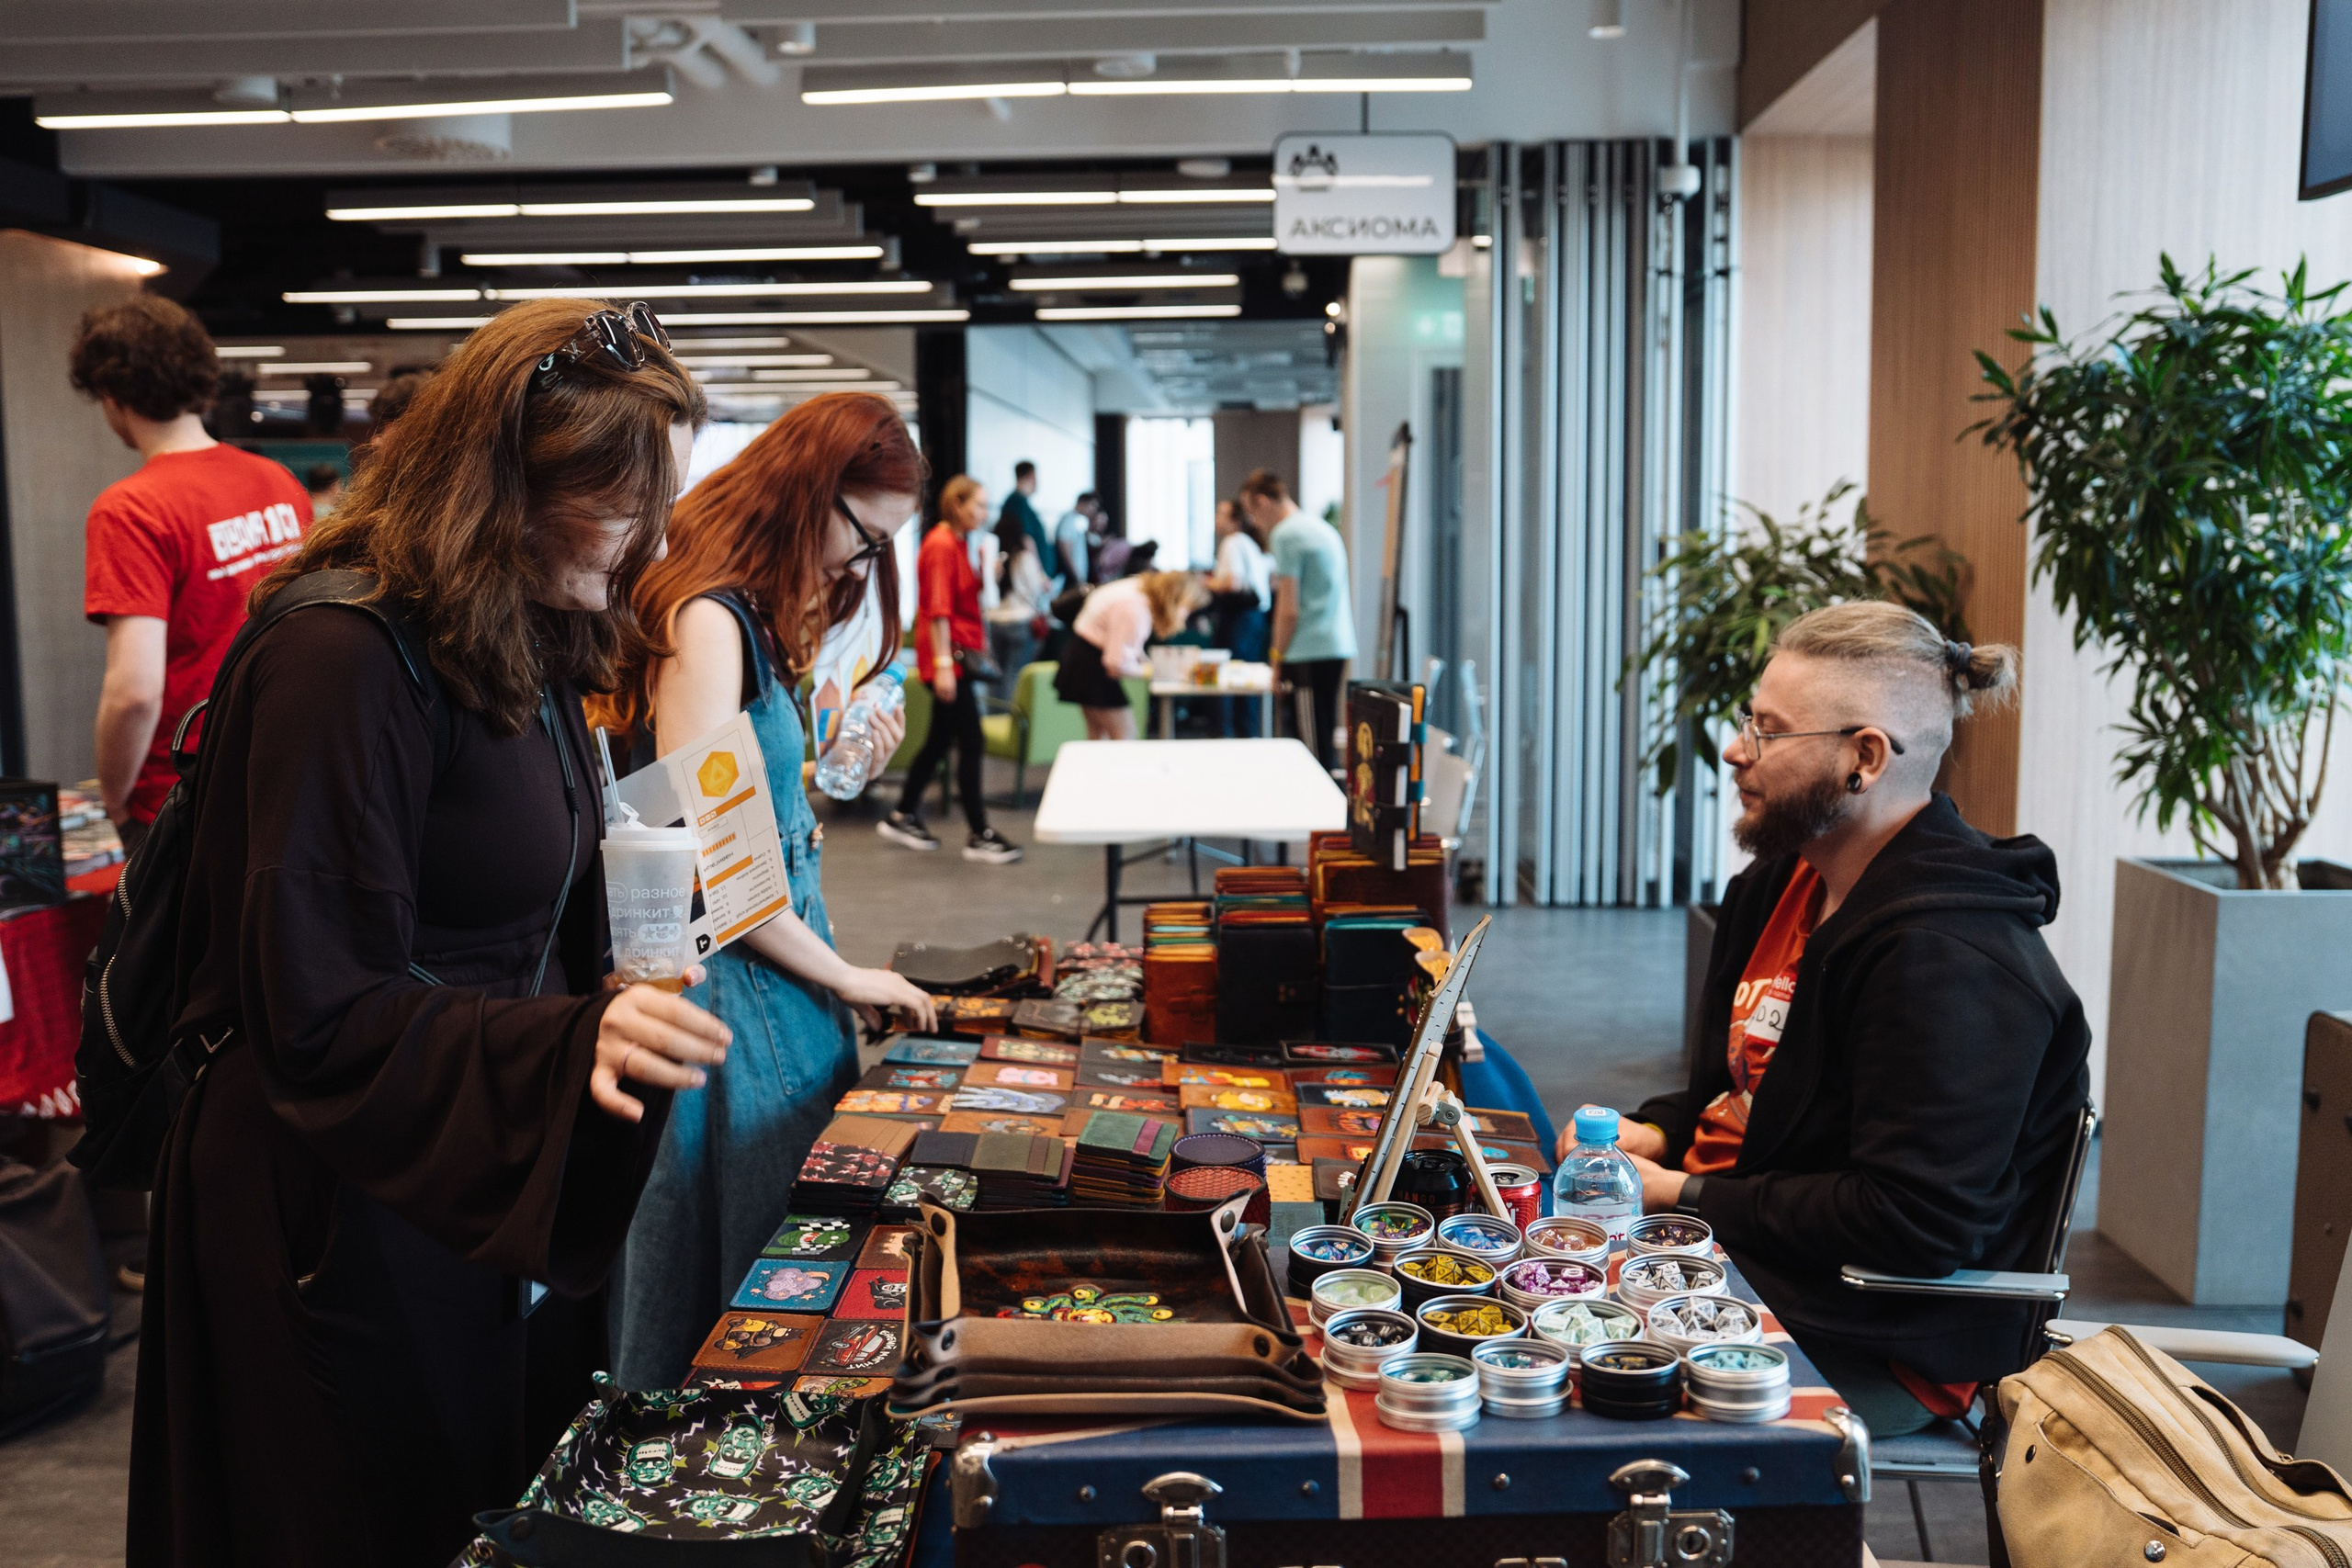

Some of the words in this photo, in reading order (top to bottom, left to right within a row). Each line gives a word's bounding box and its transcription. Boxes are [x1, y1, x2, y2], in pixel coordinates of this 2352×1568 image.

[1289, 217, 1441, 239] АКСИОМА
[630, 887, 685, 902] разное
[845, 1350, 890, 1370] МАГНИТ
